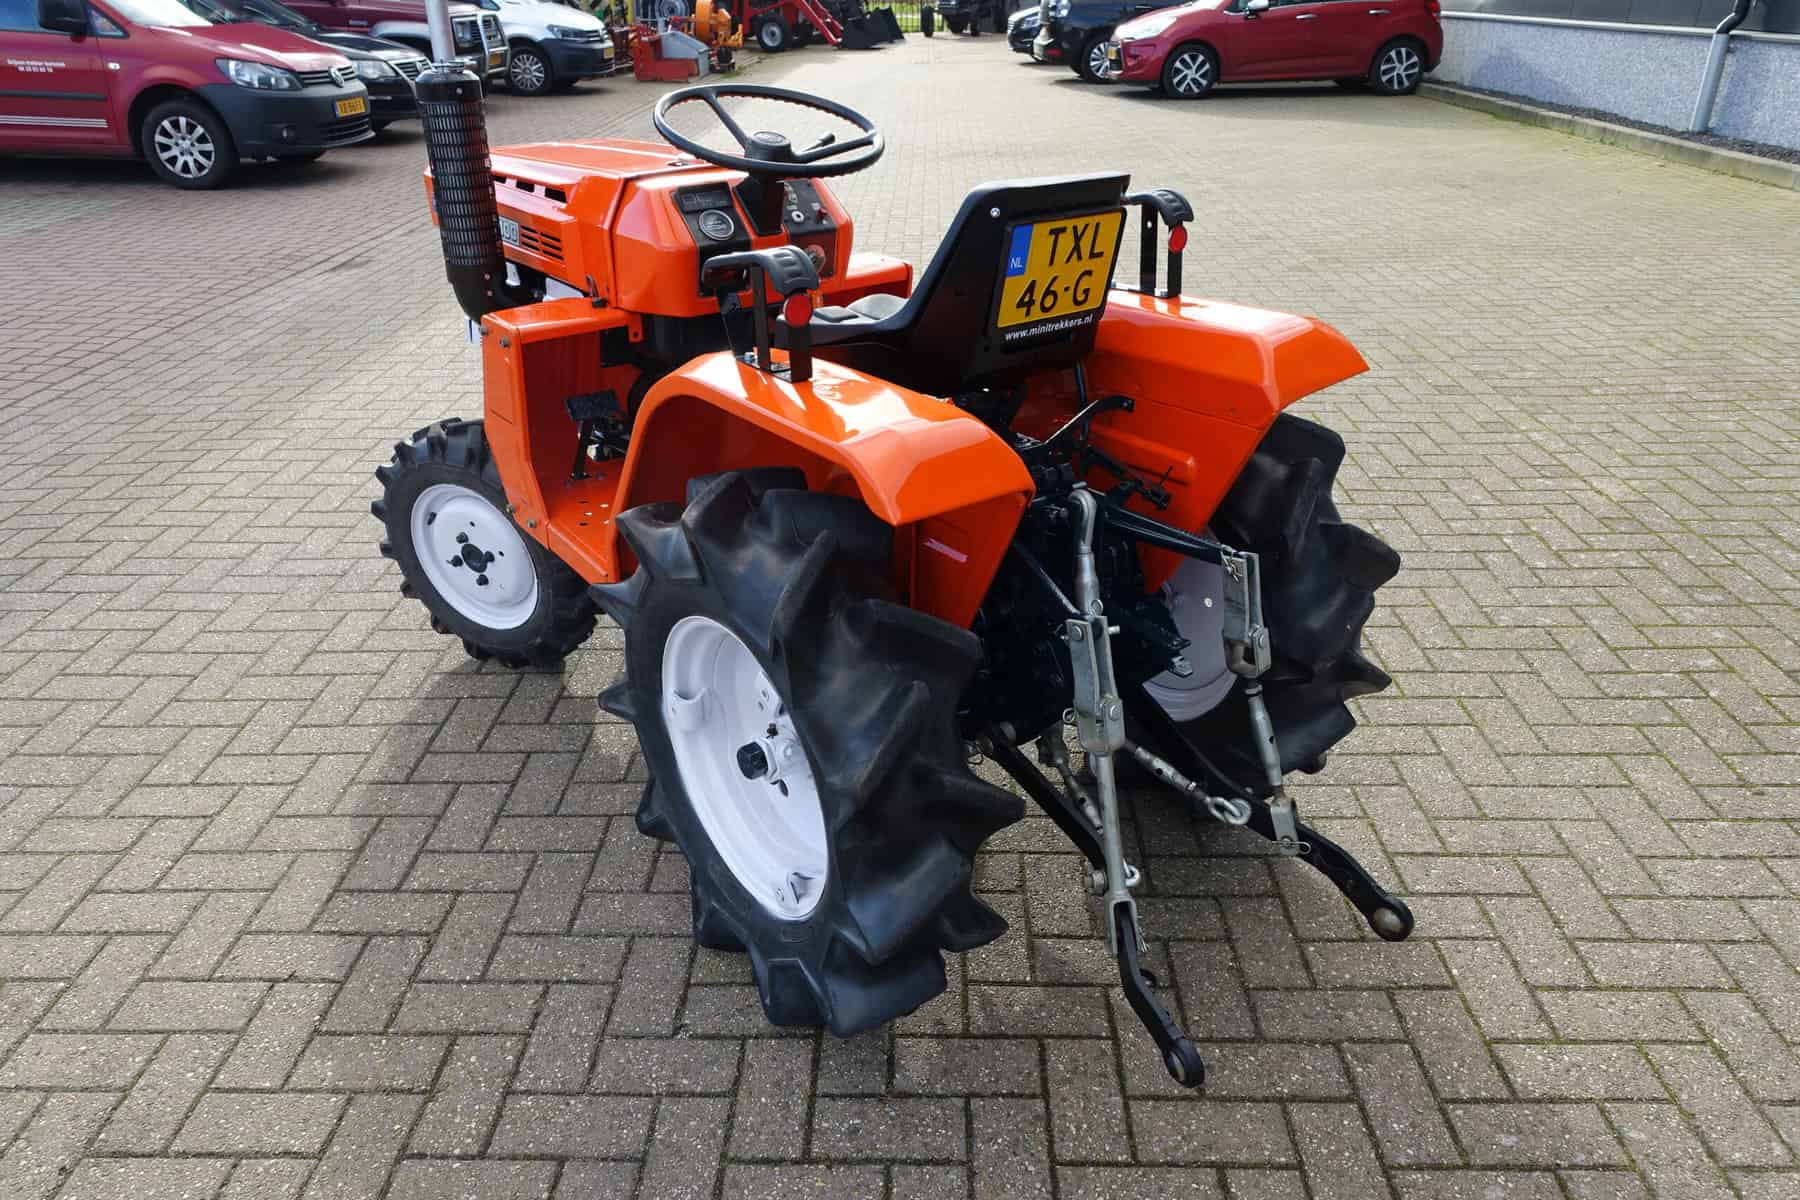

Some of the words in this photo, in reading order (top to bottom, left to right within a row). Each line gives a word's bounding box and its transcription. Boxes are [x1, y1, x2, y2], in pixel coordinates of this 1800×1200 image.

[1010, 256, 1023, 269] NL
[1048, 222, 1105, 267] TXL
[1015, 269, 1094, 318] 46-G
